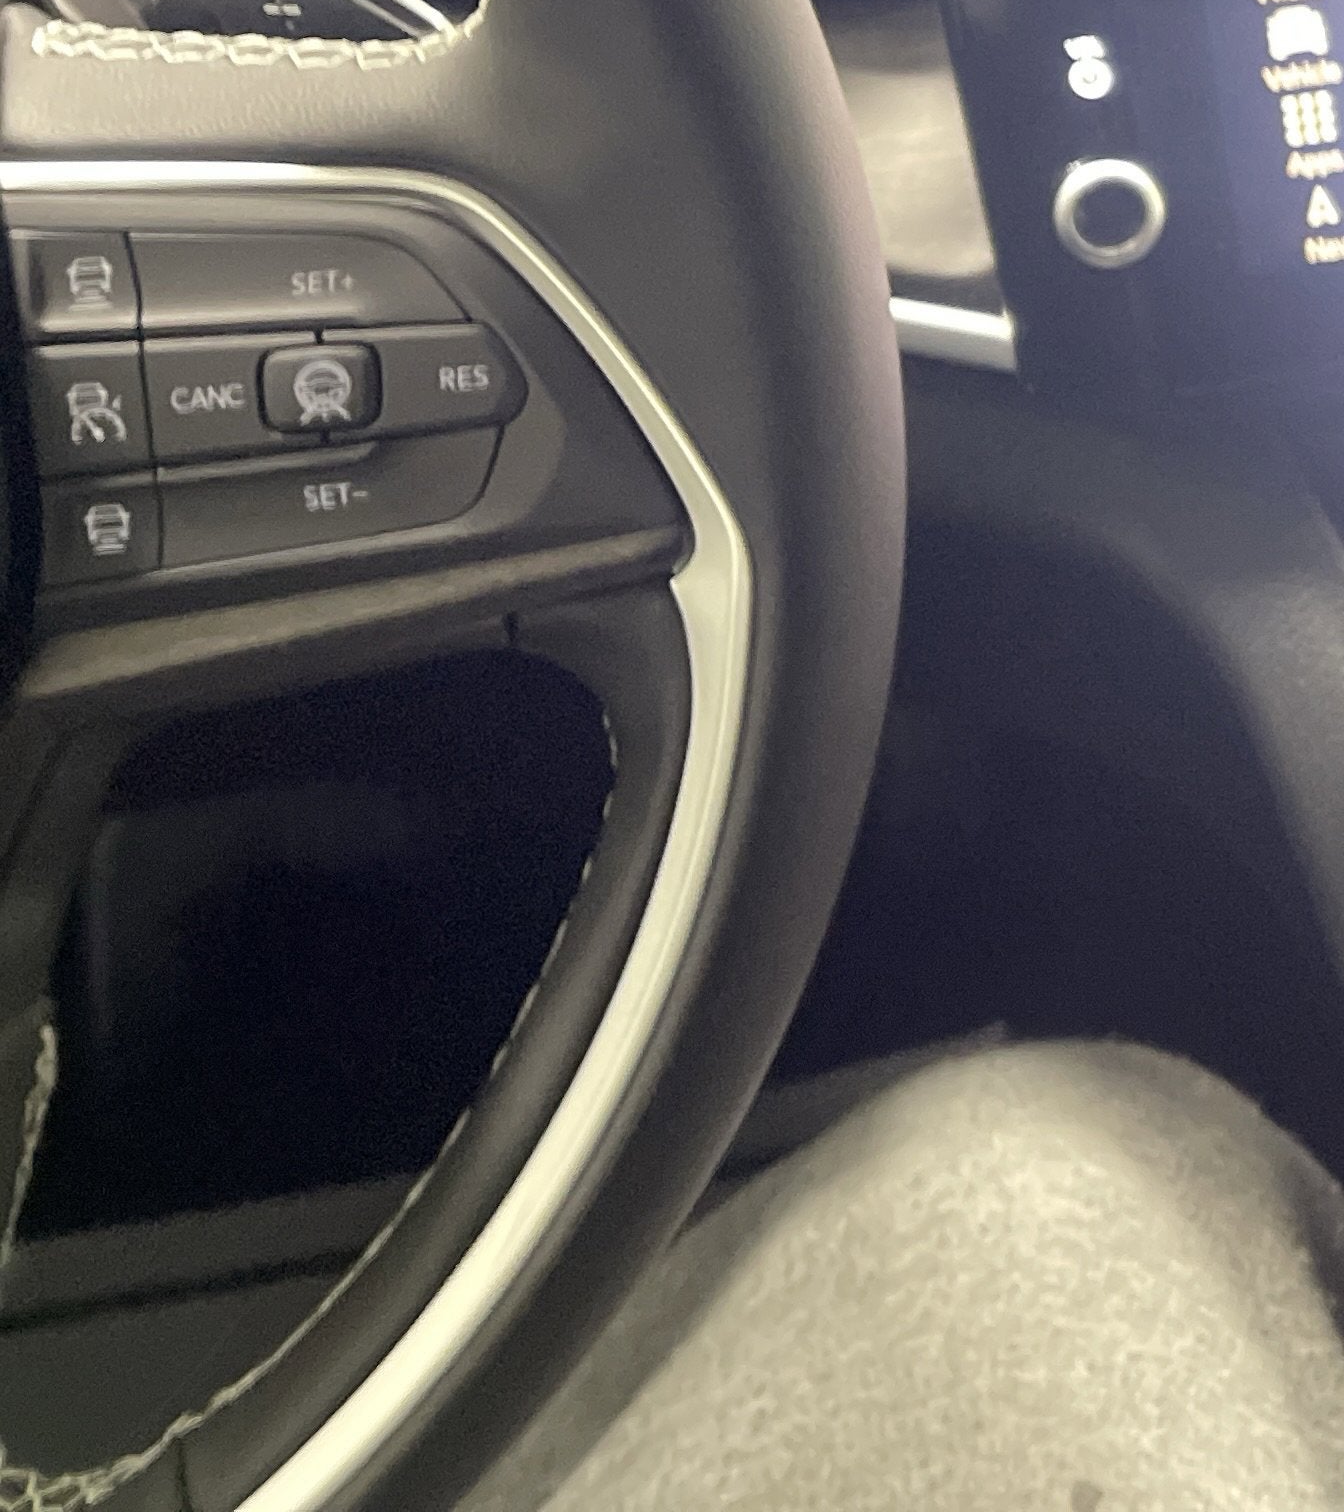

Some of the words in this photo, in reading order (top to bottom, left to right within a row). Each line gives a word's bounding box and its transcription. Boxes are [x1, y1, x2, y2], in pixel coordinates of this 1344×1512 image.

[1261, 60, 1344, 93] Vehicle
[290, 269, 356, 296] SET+
[437, 364, 490, 393] RES
[169, 382, 246, 414] CANC
[302, 482, 369, 512] SET-
